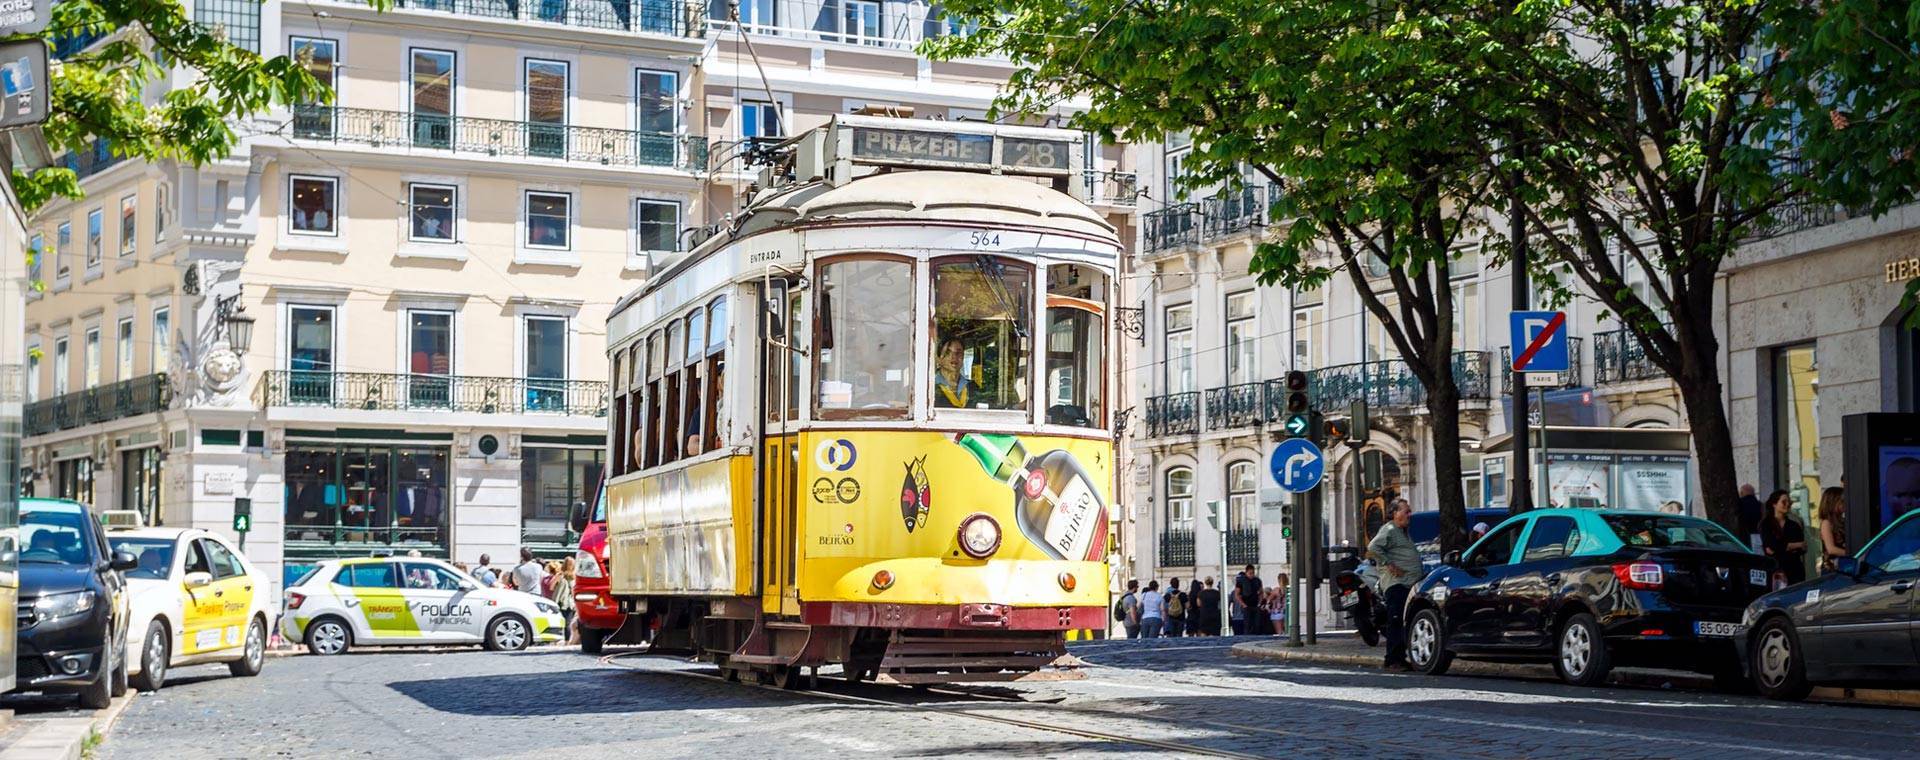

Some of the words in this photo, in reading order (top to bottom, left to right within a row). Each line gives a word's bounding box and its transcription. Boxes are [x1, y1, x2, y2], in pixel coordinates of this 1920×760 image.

[1014, 142, 1055, 168] 28
[970, 231, 1001, 247] 564
[750, 250, 782, 264] ENTRADA
[819, 534, 855, 545] BEIRÃO
